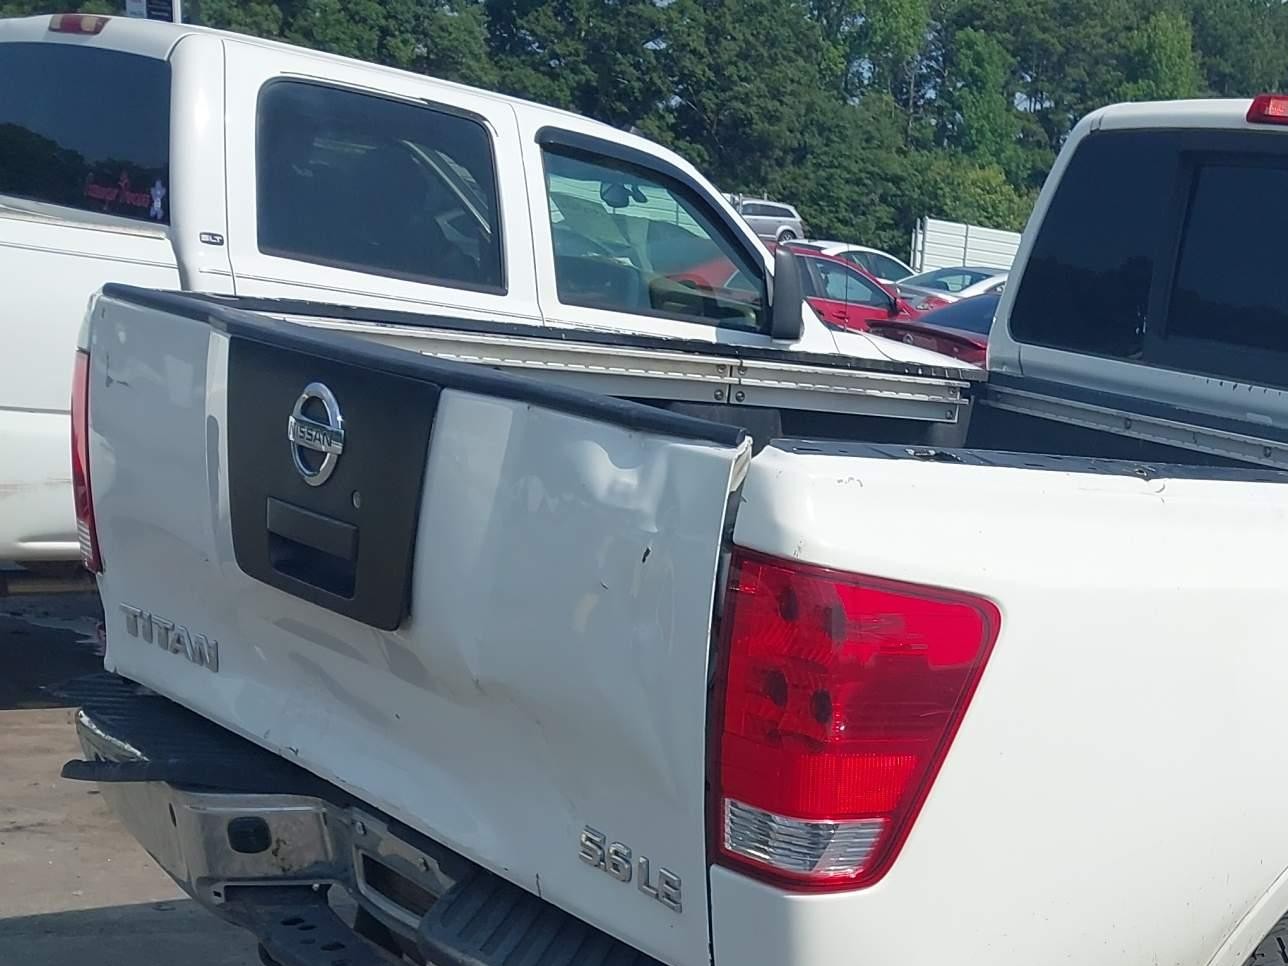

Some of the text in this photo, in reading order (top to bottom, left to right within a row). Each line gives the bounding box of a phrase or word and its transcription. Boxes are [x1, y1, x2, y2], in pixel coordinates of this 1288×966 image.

[288, 417, 333, 448] NISSAN
[119, 601, 219, 673] TITAN
[638, 856, 682, 913] LE
